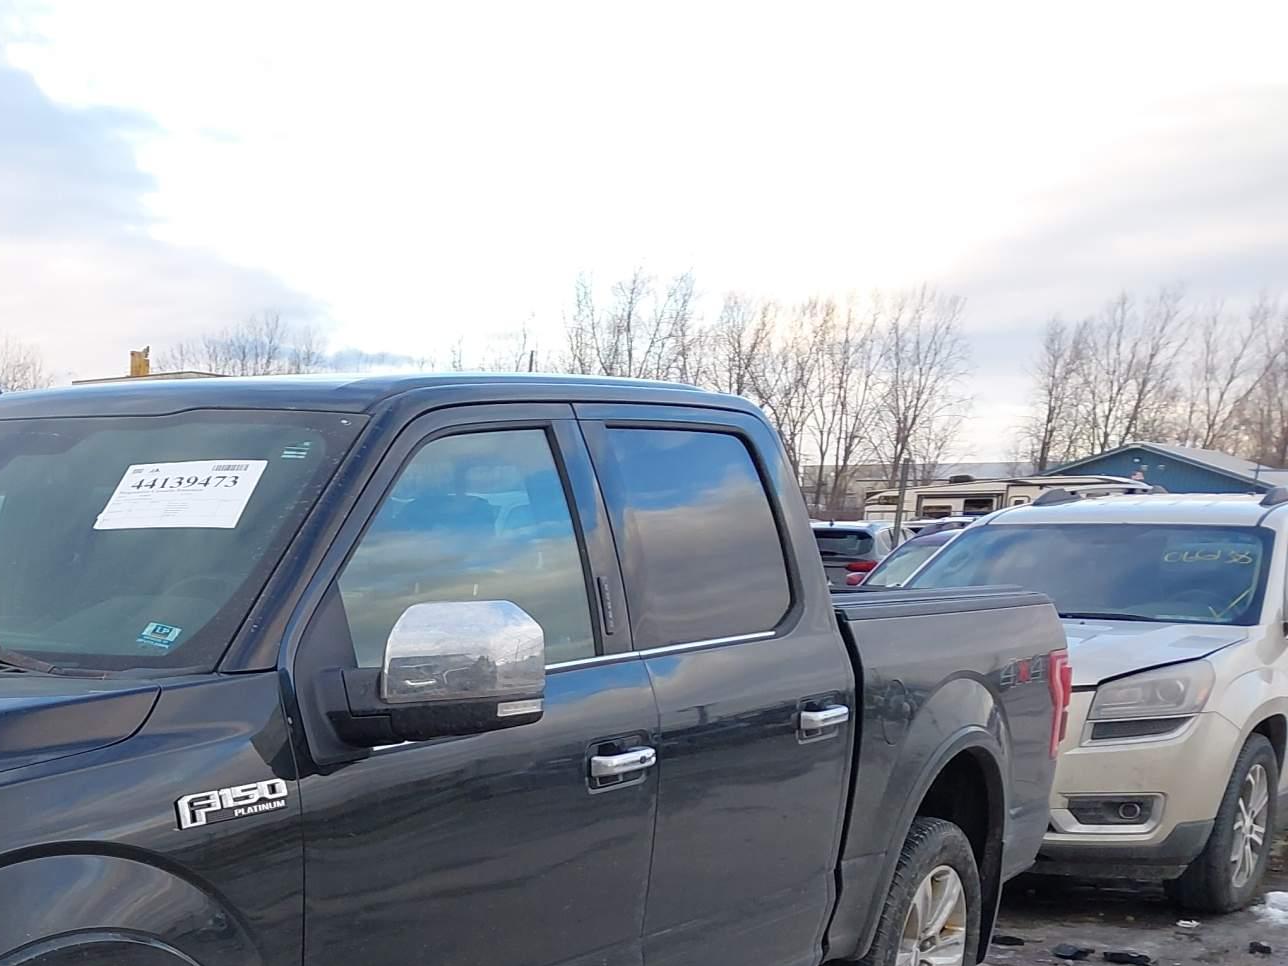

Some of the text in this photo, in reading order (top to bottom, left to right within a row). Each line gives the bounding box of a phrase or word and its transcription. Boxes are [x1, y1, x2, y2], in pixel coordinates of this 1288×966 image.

[131, 475, 239, 490] 44139473
[175, 778, 288, 829] F150
[234, 799, 286, 817] PLATINUM
